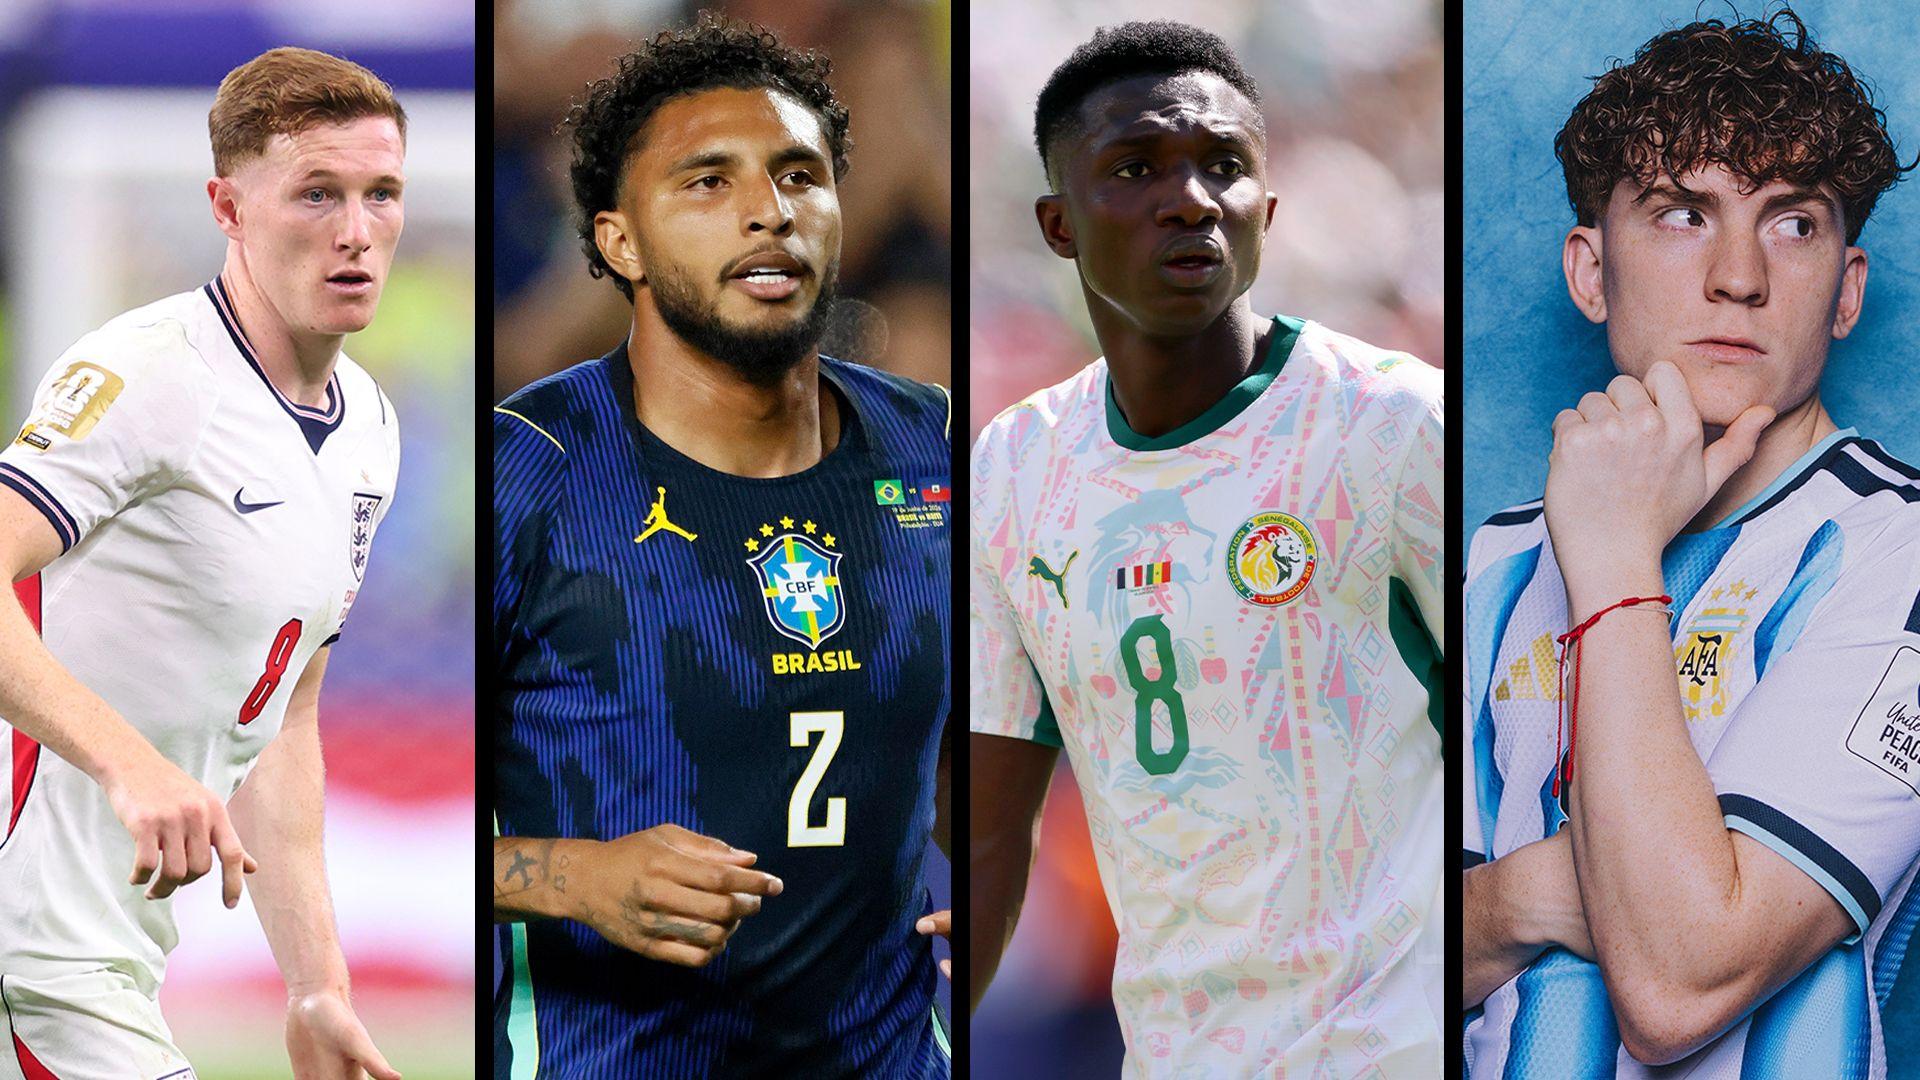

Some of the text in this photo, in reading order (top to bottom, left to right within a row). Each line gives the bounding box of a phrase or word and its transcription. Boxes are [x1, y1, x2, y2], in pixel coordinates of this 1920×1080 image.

[785, 581, 816, 594] CBF
[1303, 565, 1312, 579] DE
[1258, 580, 1306, 603] FOOTBALL
[237, 617, 303, 725] 8
[772, 649, 862, 675] BRASIL
[1678, 634, 1722, 686] AFA
[1120, 613, 1190, 776] 8
[1879, 723, 1920, 765] PEAC
[1882, 750, 1909, 773] FIFA
[787, 710, 847, 848] 2
